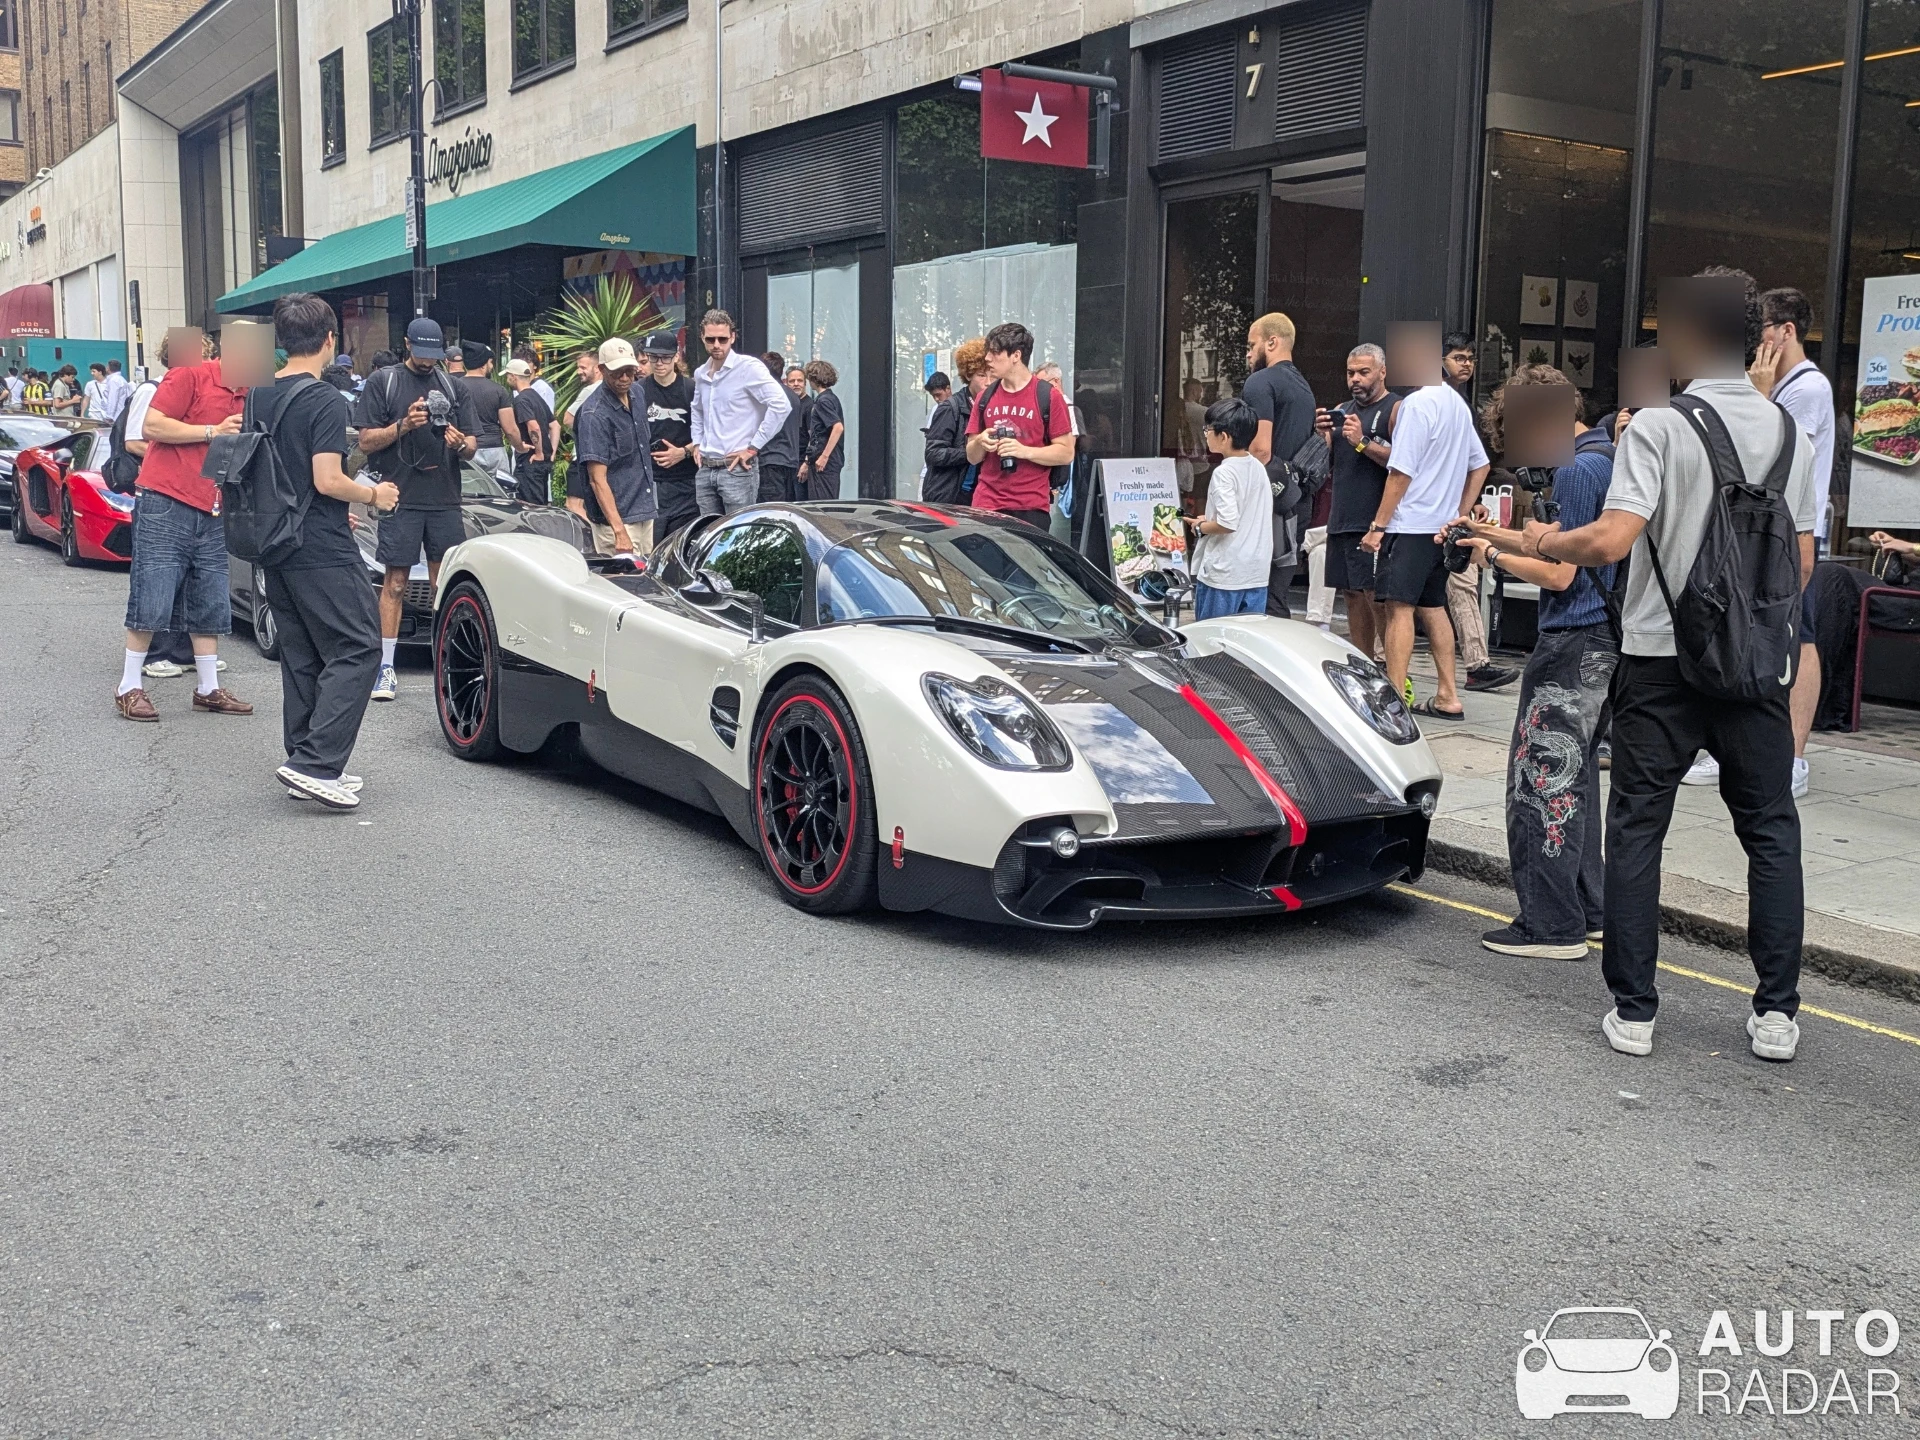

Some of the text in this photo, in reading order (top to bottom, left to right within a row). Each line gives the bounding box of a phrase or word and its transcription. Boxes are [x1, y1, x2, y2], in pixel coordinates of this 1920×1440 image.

[1246, 63, 1265, 99] 7
[706, 290, 713, 306] 8
[1897, 295, 1920, 310] Fre
[11, 327, 50, 335] BENARES
[1869, 361, 1888, 374] 36g
[986, 405, 1034, 420] CANADA
[1120, 481, 1165, 491] Freshly made
[1113, 491, 1174, 502] Protein packed
